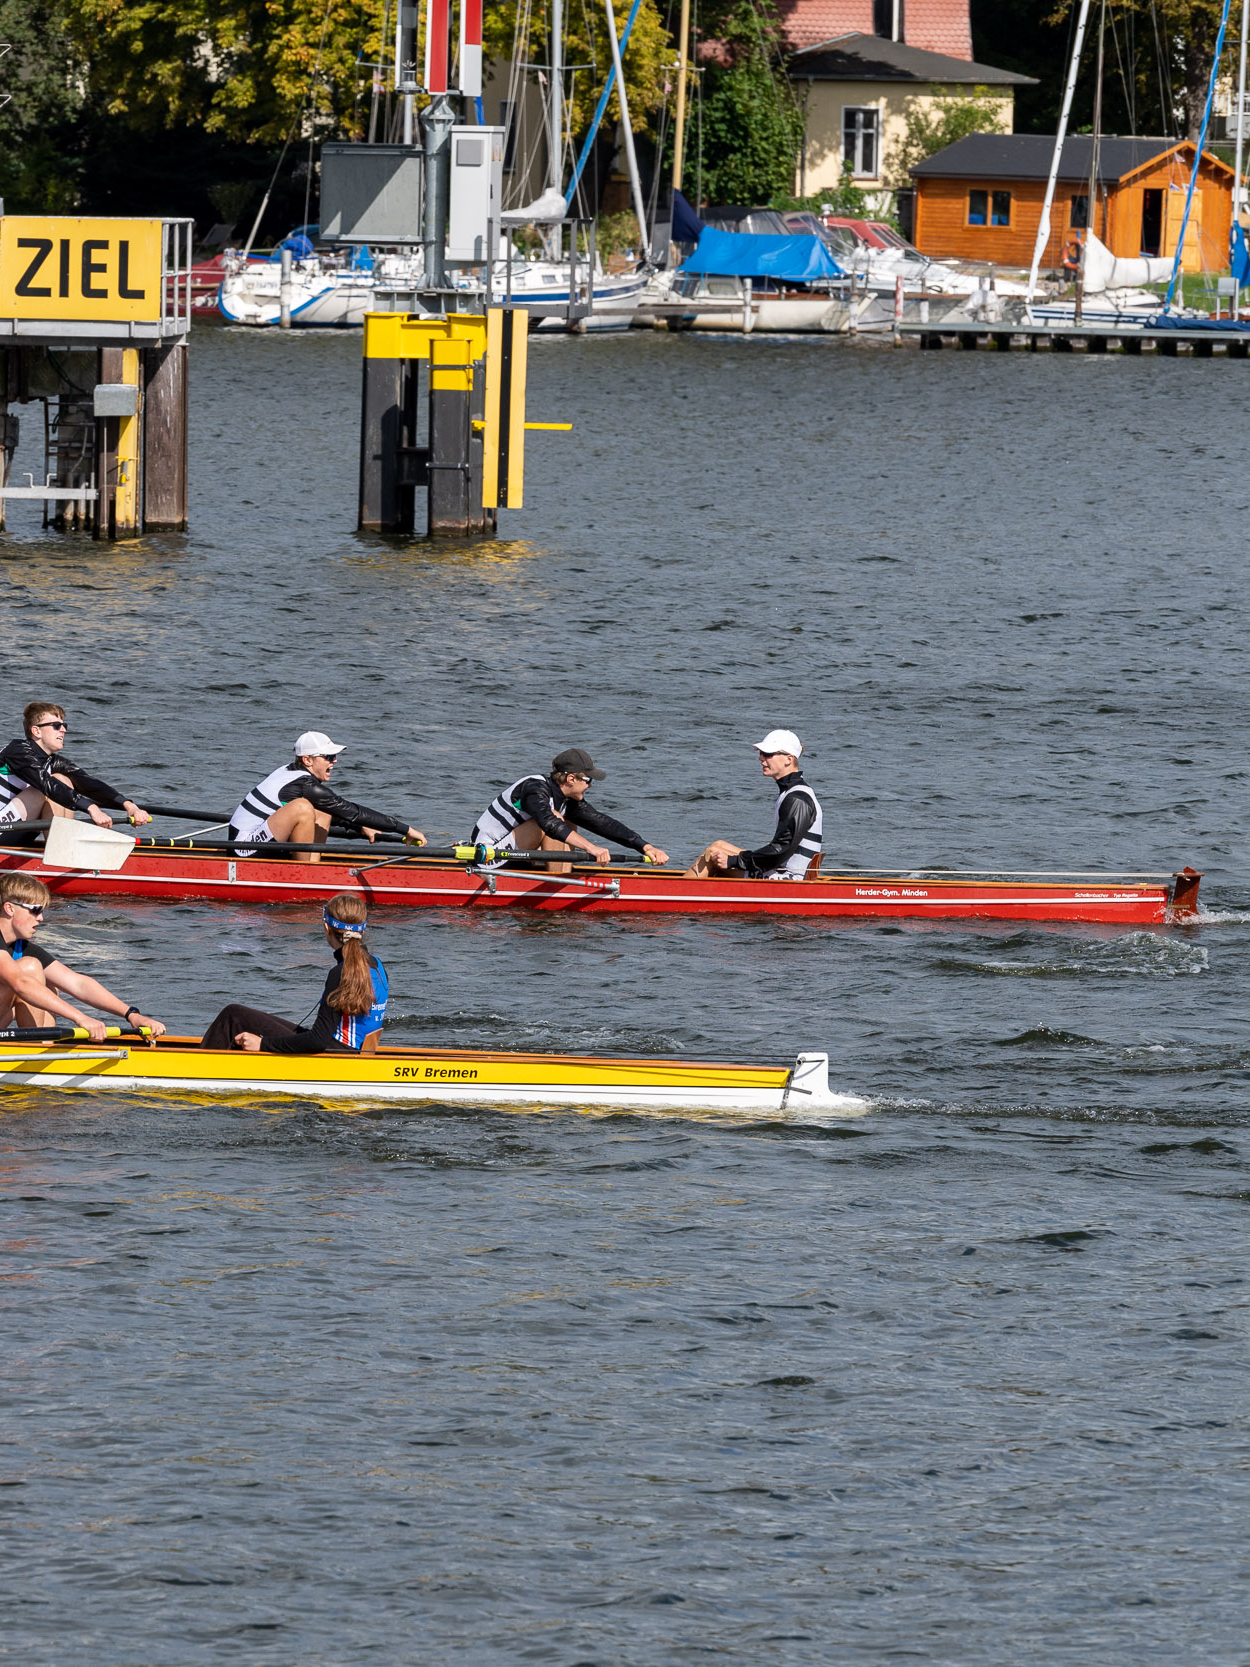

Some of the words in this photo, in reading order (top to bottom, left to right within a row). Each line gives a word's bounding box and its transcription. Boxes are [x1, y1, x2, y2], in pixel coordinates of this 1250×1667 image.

[15, 238, 146, 300] ZIEL
[855, 888, 900, 898] Herder-Gym.
[901, 888, 928, 897] Minden
[393, 1066, 419, 1077] SRV
[424, 1067, 478, 1079] Bremen
